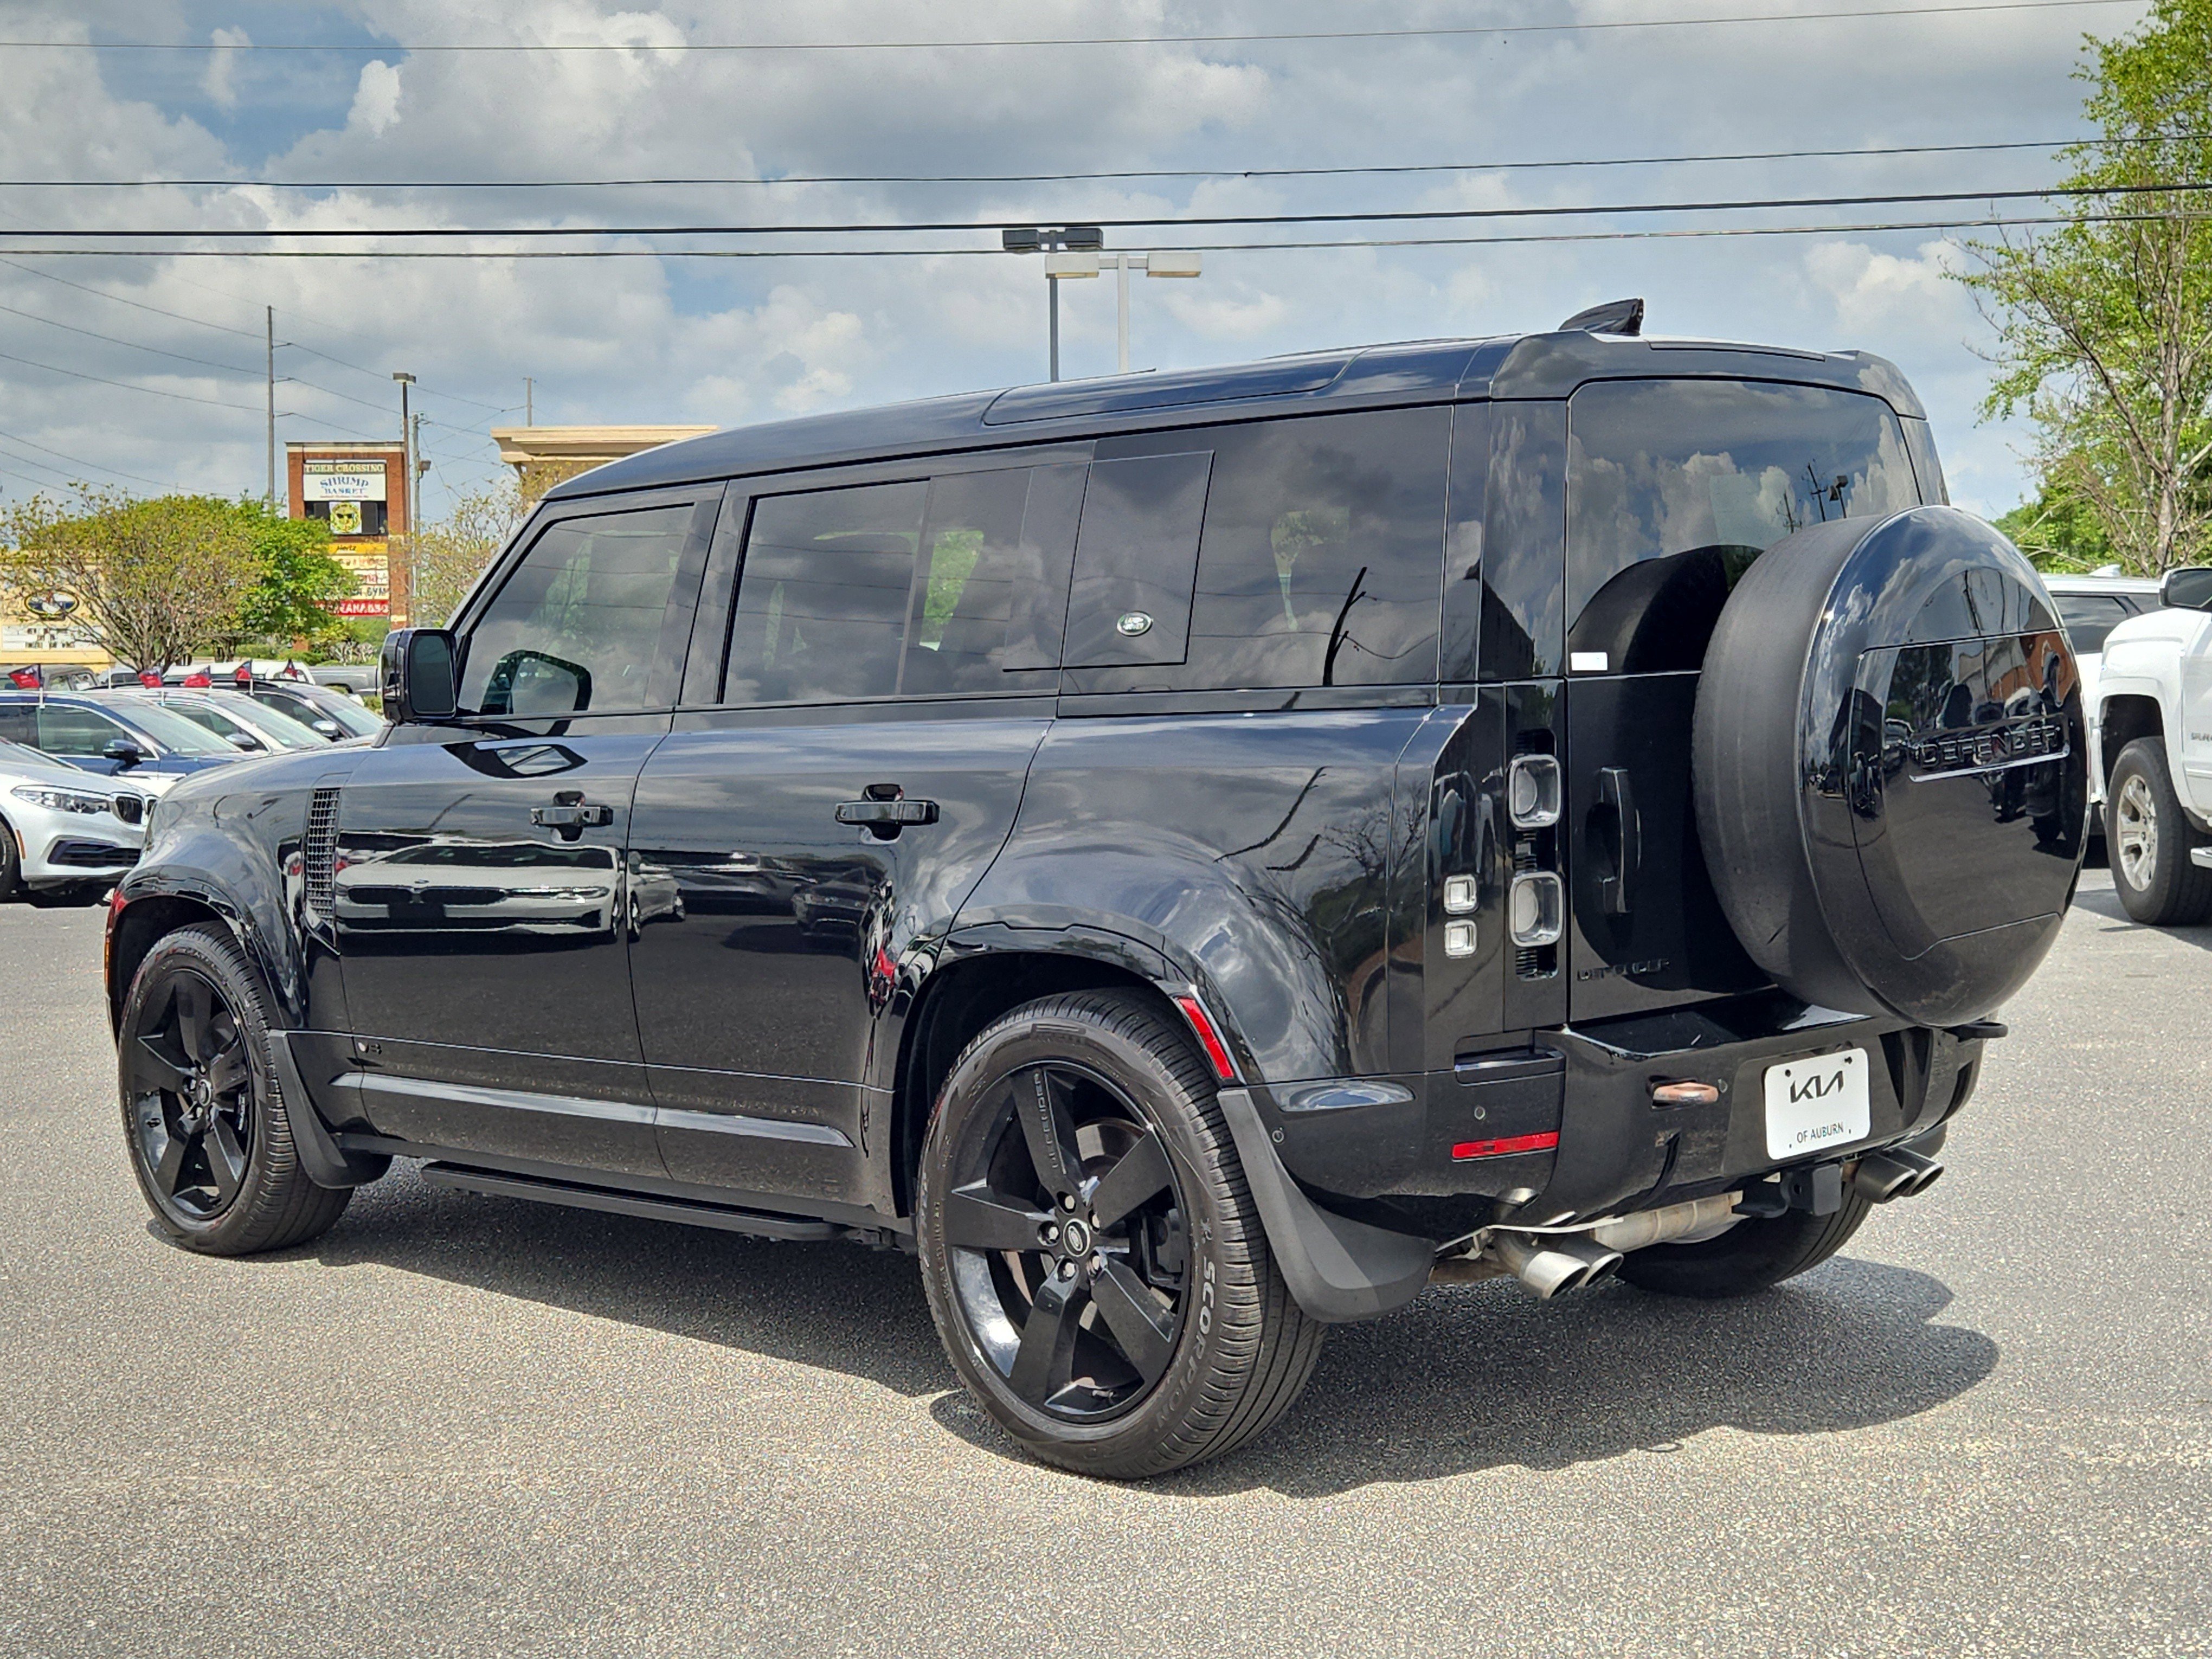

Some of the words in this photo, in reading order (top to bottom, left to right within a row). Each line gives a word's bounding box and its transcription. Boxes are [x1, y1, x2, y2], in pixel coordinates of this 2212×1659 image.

[305, 464, 333, 472] TIGER
[336, 464, 383, 472] CROSSING
[320, 476, 369, 487] SHRIMP
[1920, 724, 2061, 770] DEFENDER
[1790, 1070, 1844, 1104] KIA
[1796, 1130, 1808, 1143] OF
[1810, 1122, 1844, 1140] AUBURN
[1154, 1255, 1216, 1430] SCORPION
